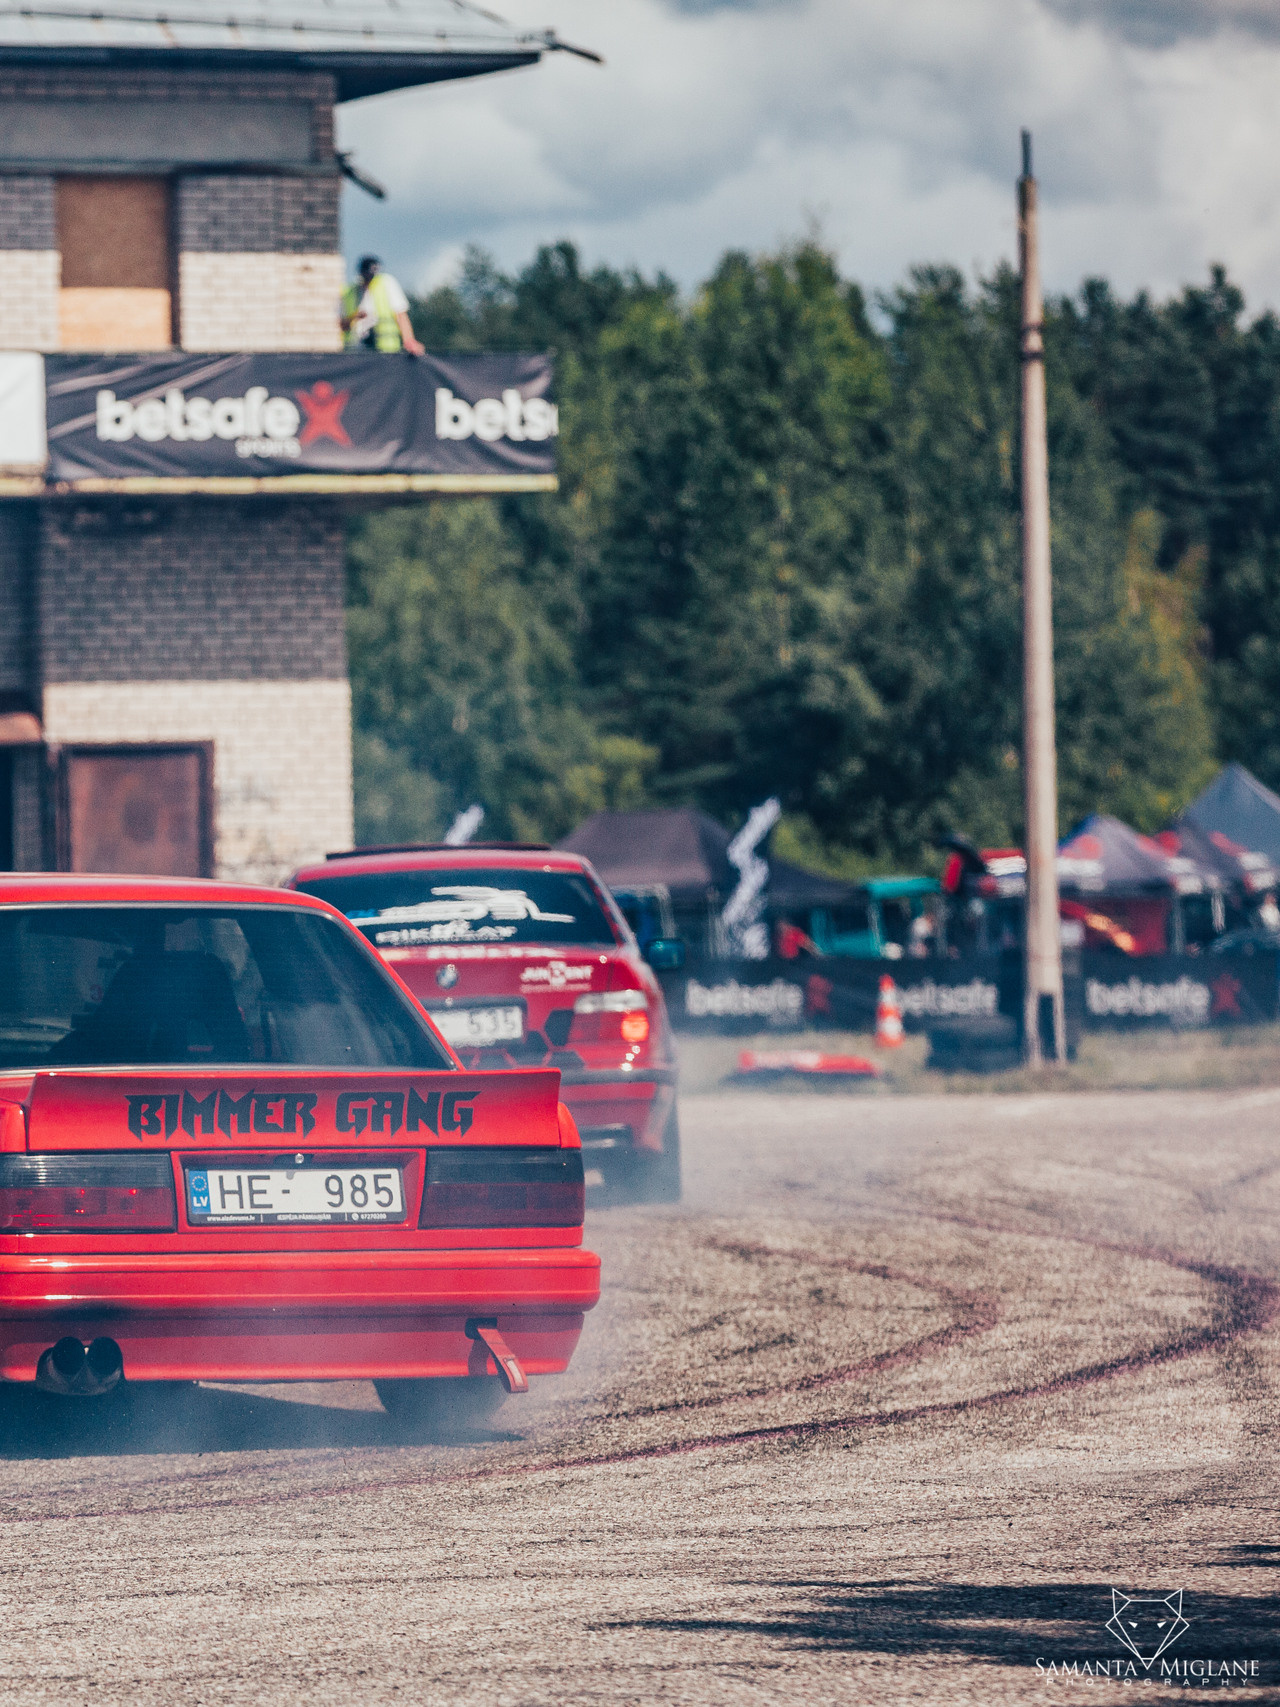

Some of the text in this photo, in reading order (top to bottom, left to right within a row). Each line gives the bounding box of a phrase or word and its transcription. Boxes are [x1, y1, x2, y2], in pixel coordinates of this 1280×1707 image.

[96, 385, 301, 442] betsafe
[435, 387, 559, 442] bets
[123, 1087, 482, 1142] BIMMER GANG
[192, 1196, 209, 1208] LV
[324, 1173, 394, 1208] 985
